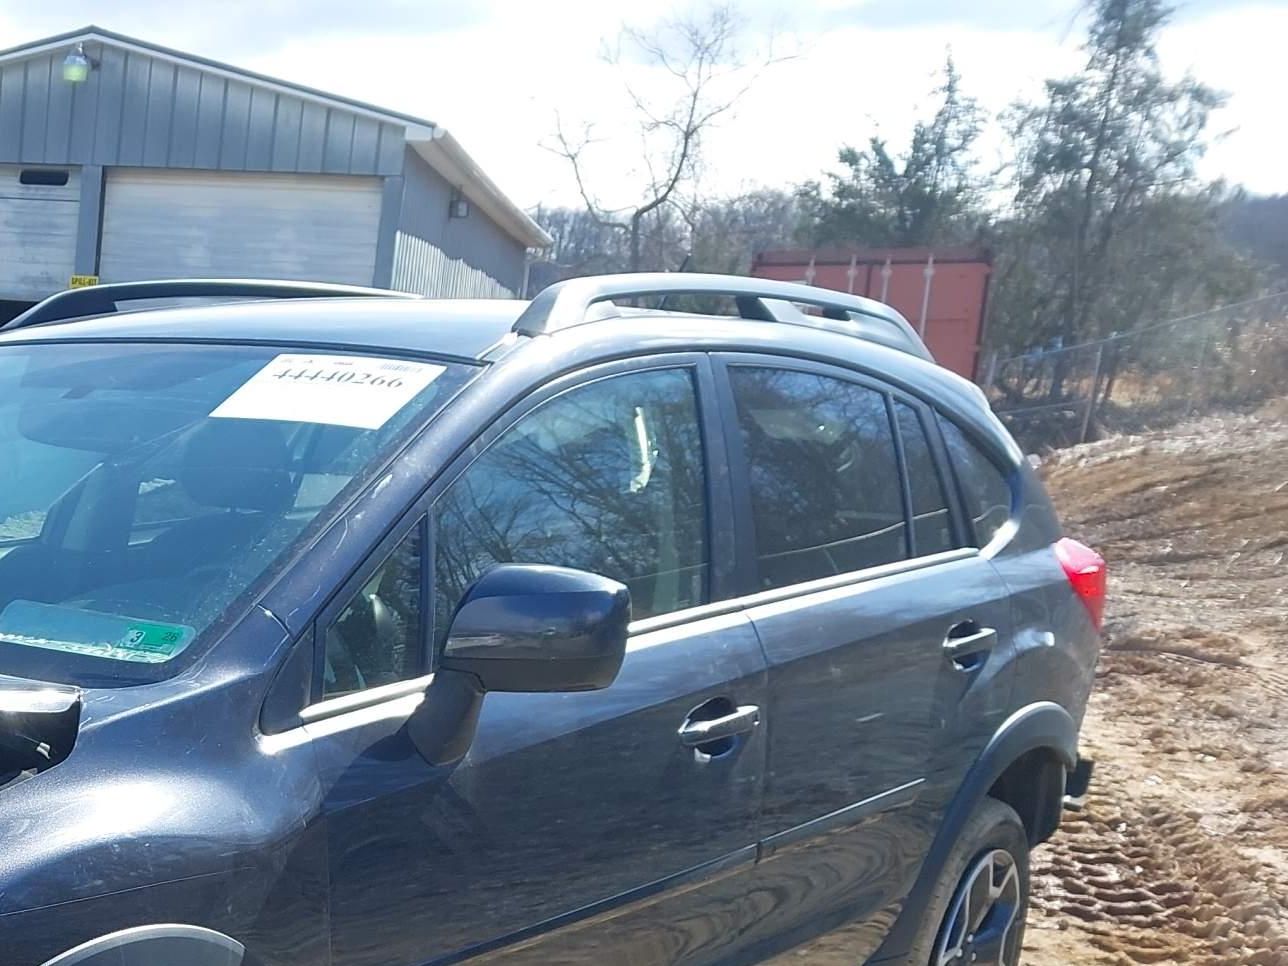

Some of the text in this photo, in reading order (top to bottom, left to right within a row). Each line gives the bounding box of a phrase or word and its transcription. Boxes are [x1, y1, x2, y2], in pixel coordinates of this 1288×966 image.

[272, 368, 403, 388] 44440266
[130, 631, 179, 643] 3 26
